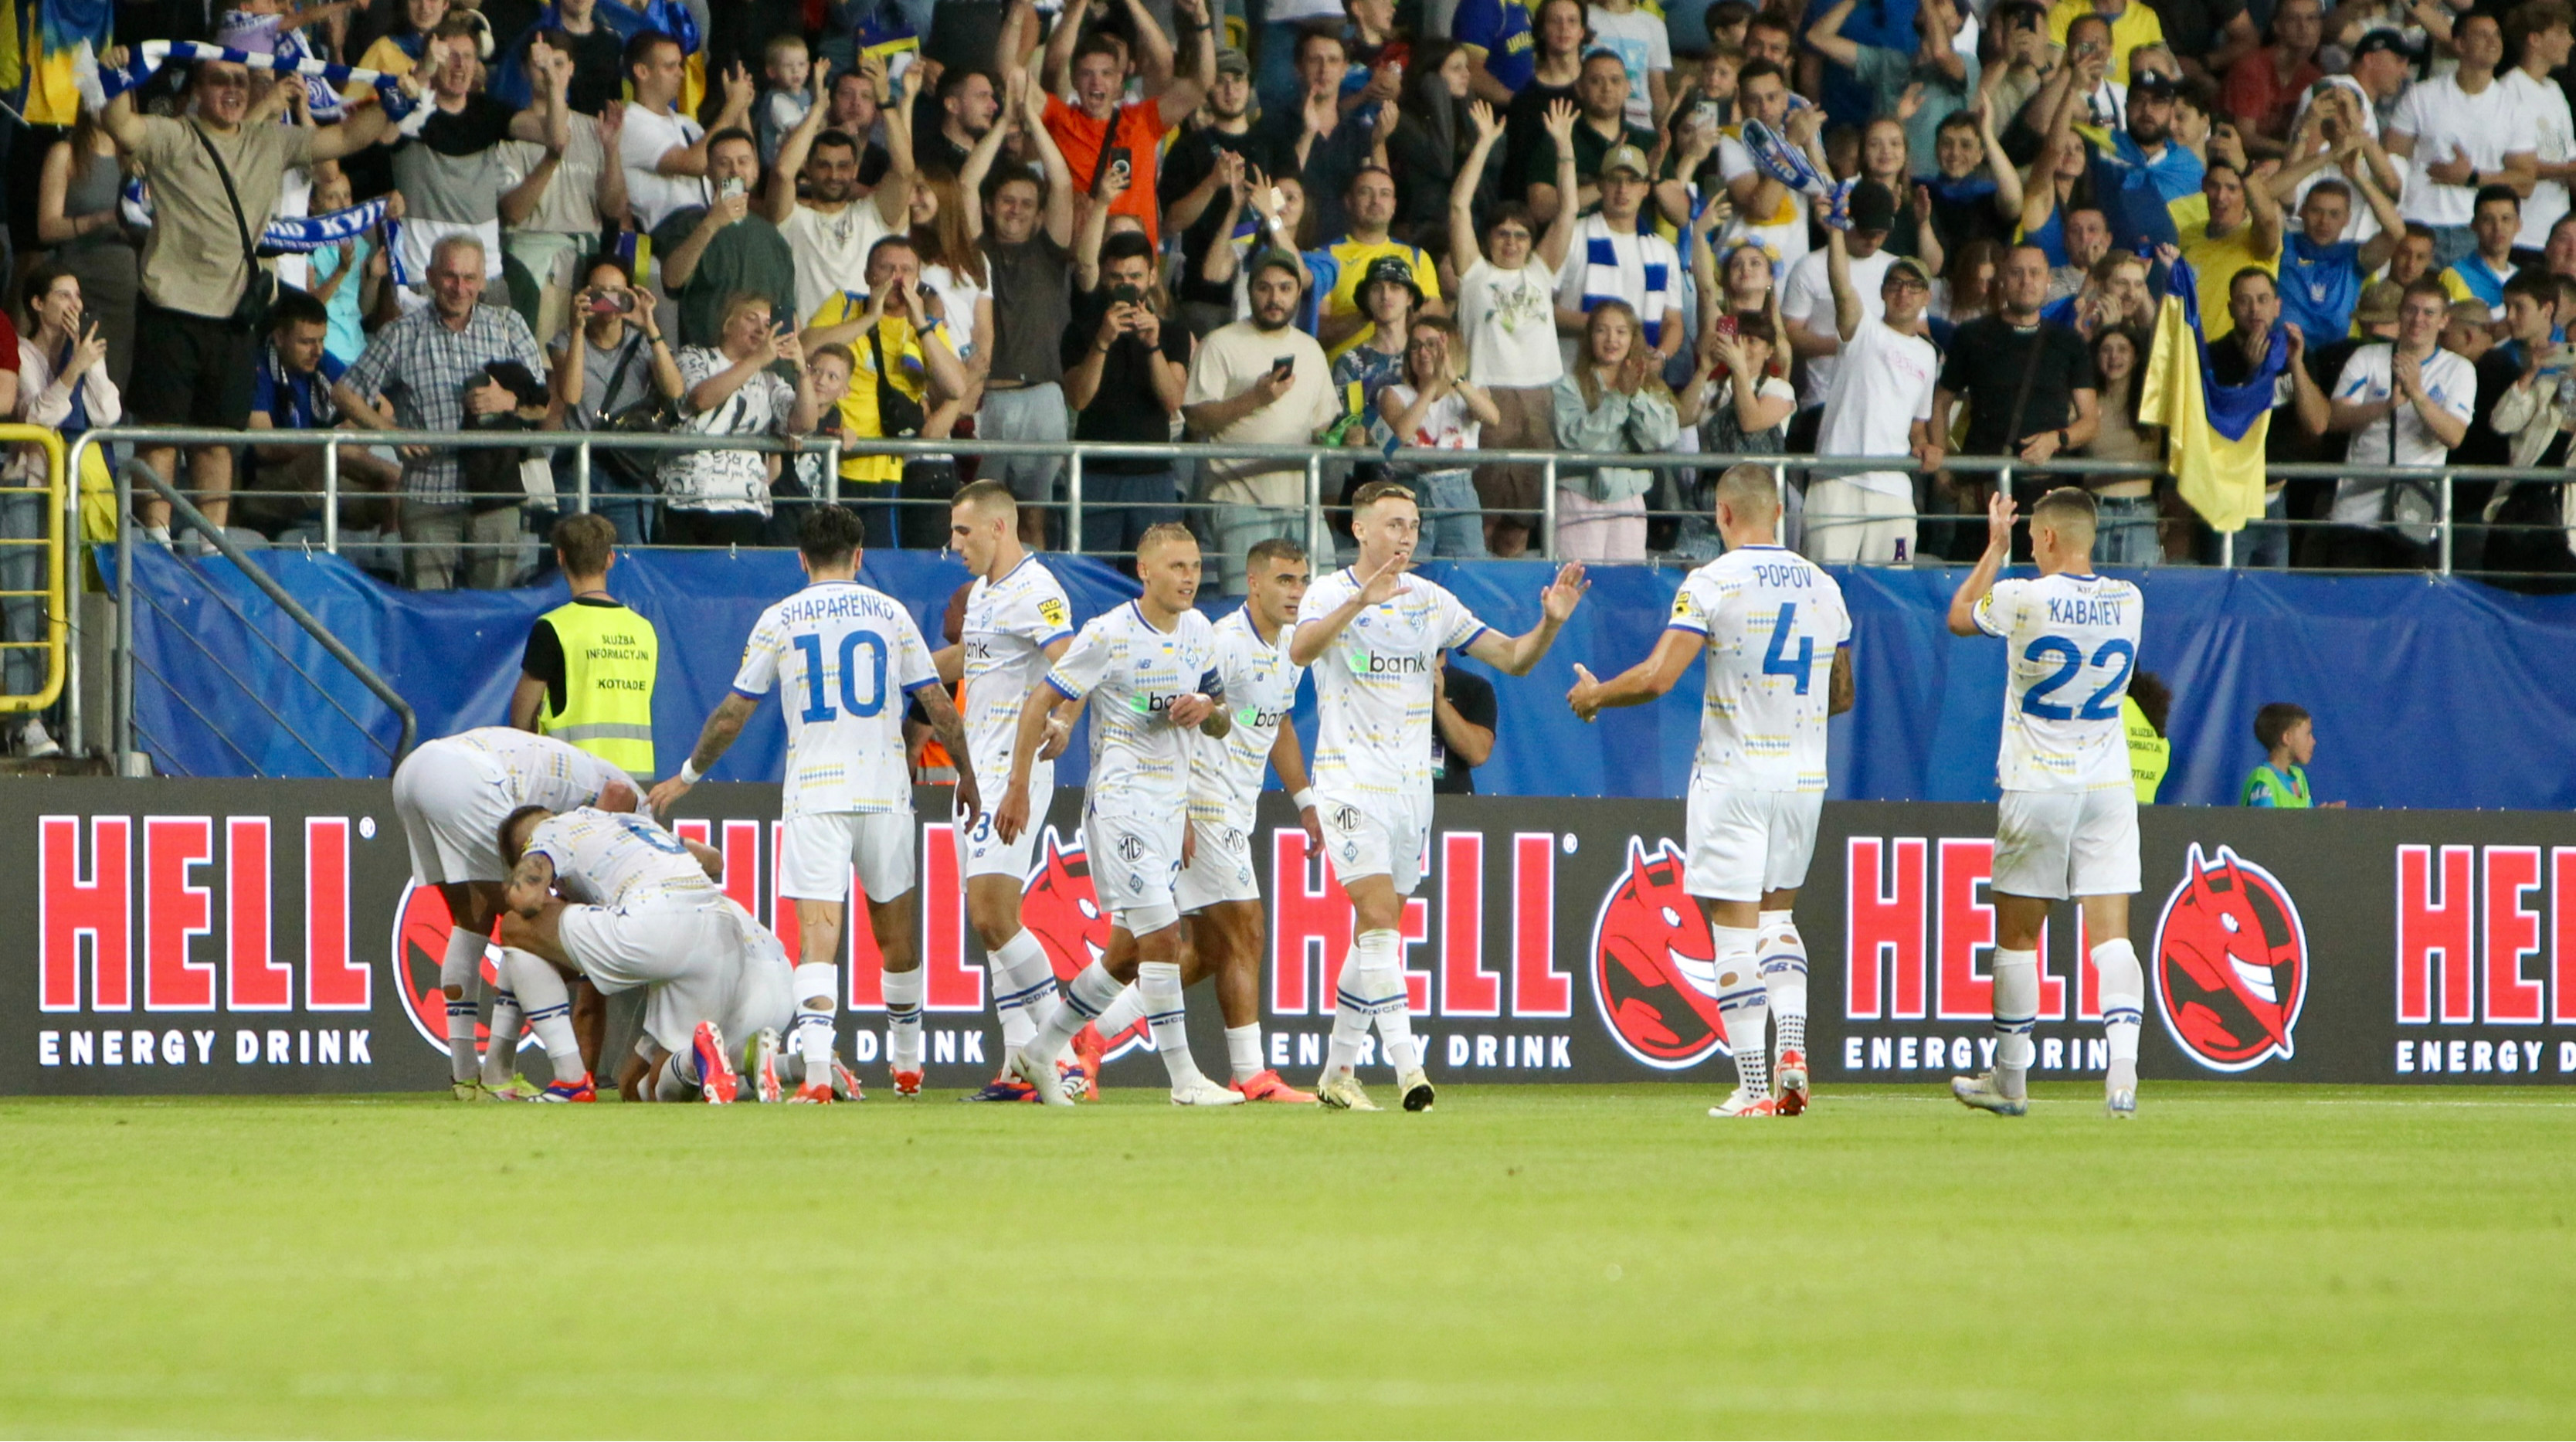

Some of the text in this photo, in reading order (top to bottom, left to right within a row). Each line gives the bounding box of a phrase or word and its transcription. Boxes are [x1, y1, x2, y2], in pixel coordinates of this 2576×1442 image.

[1756, 565, 1812, 588] POPOV
[782, 595, 894, 626] SHAPARENKO
[2049, 598, 2121, 625] KABAIEV
[1762, 602, 1814, 695] 4
[597, 679, 646, 690] KOTRADE
[793, 630, 888, 724] 10
[2021, 636, 2134, 721] 22
[38, 815, 372, 1012] HELL
[1846, 836, 2105, 1020] HE
[39, 1030, 372, 1066] ENERGY DRINK
[1271, 1032, 1572, 1067] ENRY DRINK
[1845, 1037, 2108, 1070] ENERGY RIN
[2397, 1040, 2544, 1072] ENERGY
